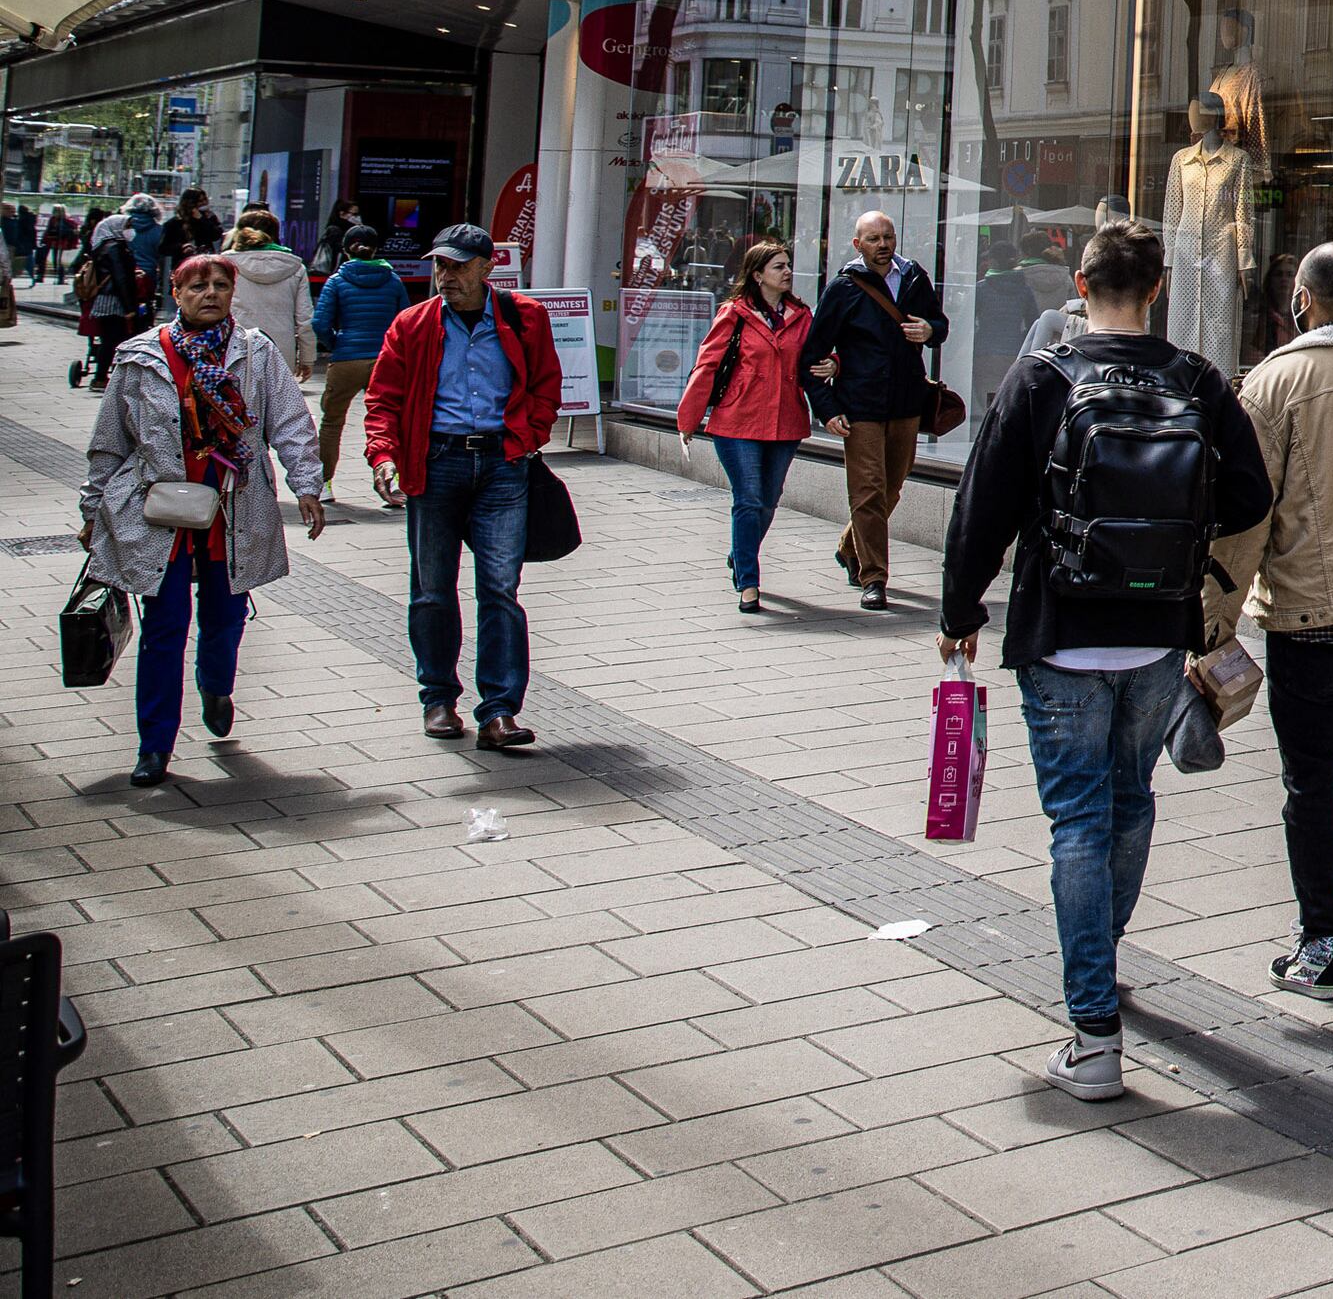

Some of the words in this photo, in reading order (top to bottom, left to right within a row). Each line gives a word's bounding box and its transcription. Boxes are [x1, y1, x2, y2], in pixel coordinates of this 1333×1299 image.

[602, 37, 684, 59] Gerngross
[836, 153, 927, 189] ZARA
[507, 199, 536, 243] GRATIS
[541, 300, 586, 309] RONATEST
